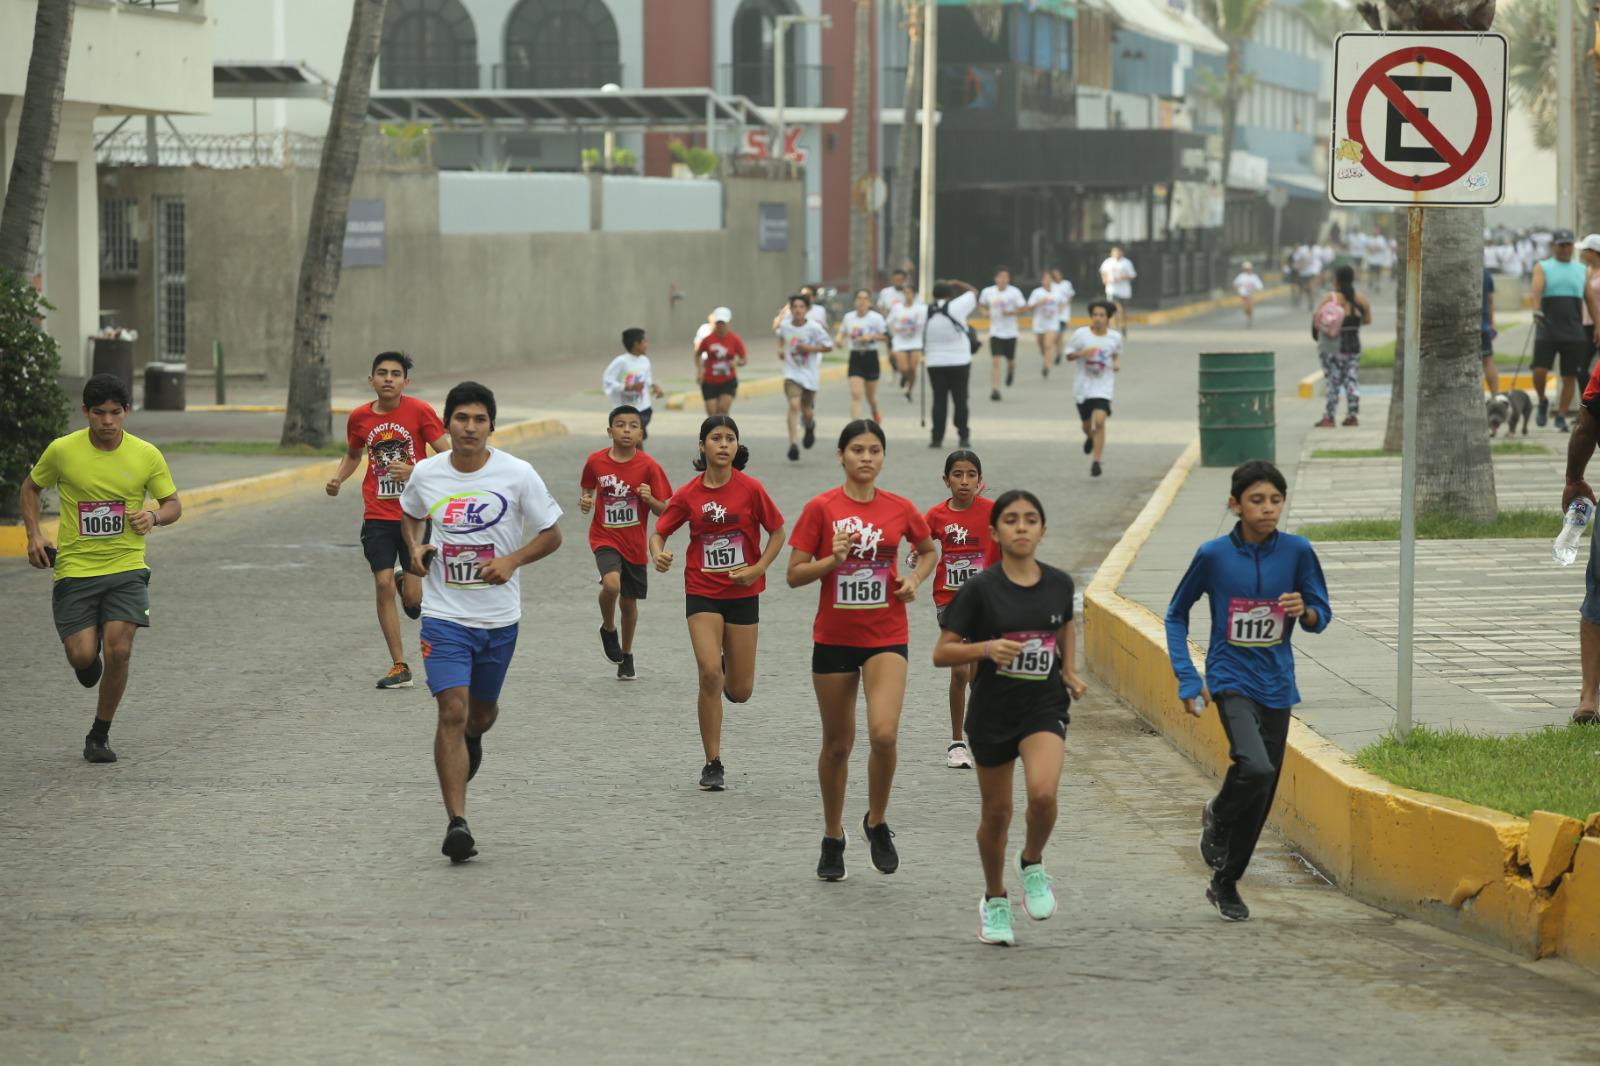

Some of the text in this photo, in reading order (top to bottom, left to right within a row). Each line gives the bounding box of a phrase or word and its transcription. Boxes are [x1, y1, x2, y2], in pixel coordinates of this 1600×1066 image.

[1384, 75, 1452, 163] E
[373, 422, 389, 434] NOT
[380, 480, 405, 494] 1176
[442, 503, 489, 524] 5K
[606, 508, 633, 523] 1140
[83, 515, 122, 533] 1068
[705, 547, 736, 567] 1157
[839, 581, 882, 601] 1158
[1234, 618, 1275, 639] 1112
